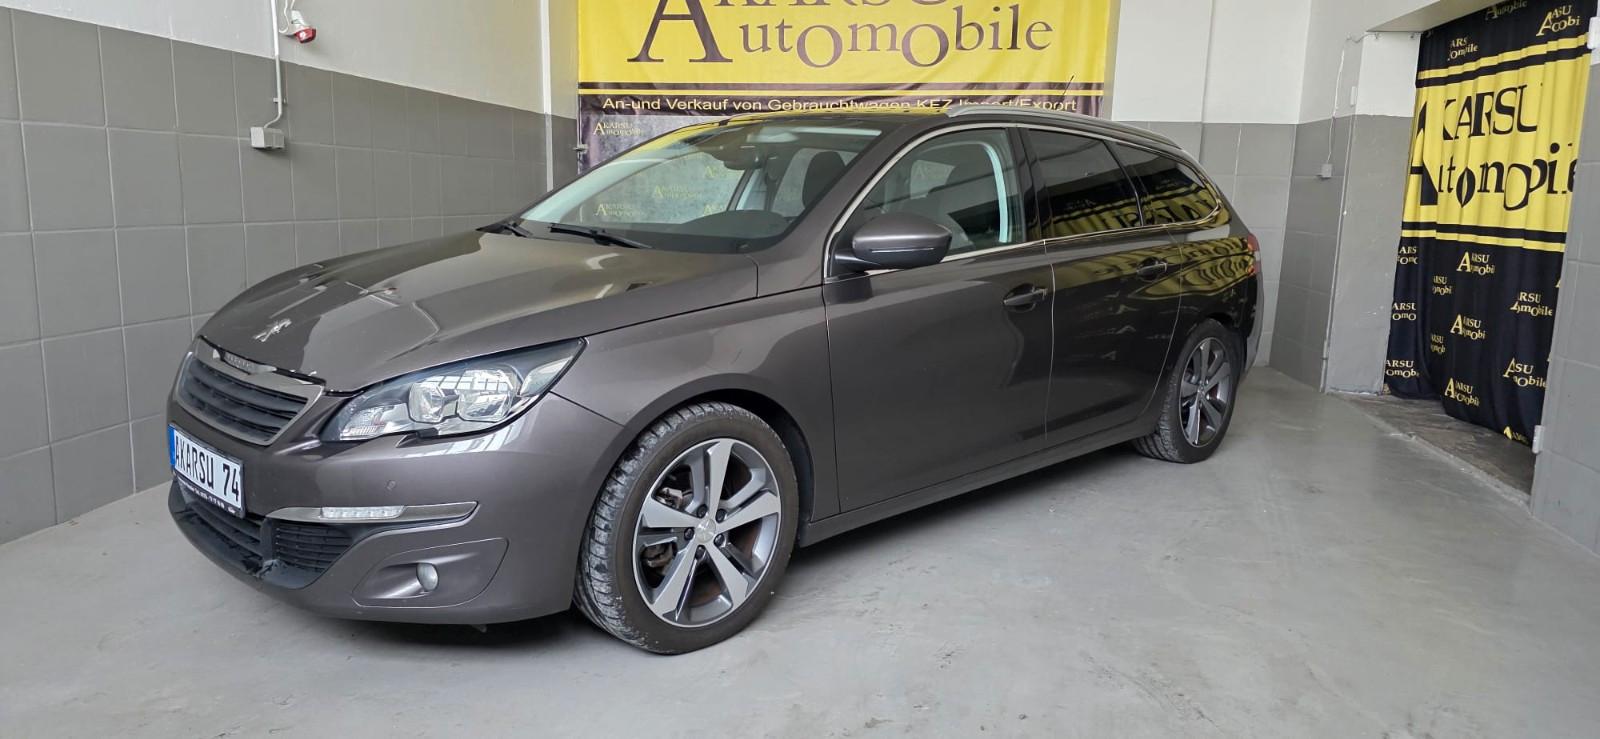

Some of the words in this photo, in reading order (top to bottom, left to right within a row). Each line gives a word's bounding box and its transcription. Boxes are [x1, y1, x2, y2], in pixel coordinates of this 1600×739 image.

[602, 98, 661, 111] An-und
[666, 98, 729, 111] Verkauf
[732, 100, 762, 111] von
[176, 435, 214, 490] AKARSU
[222, 463, 240, 502] 74
